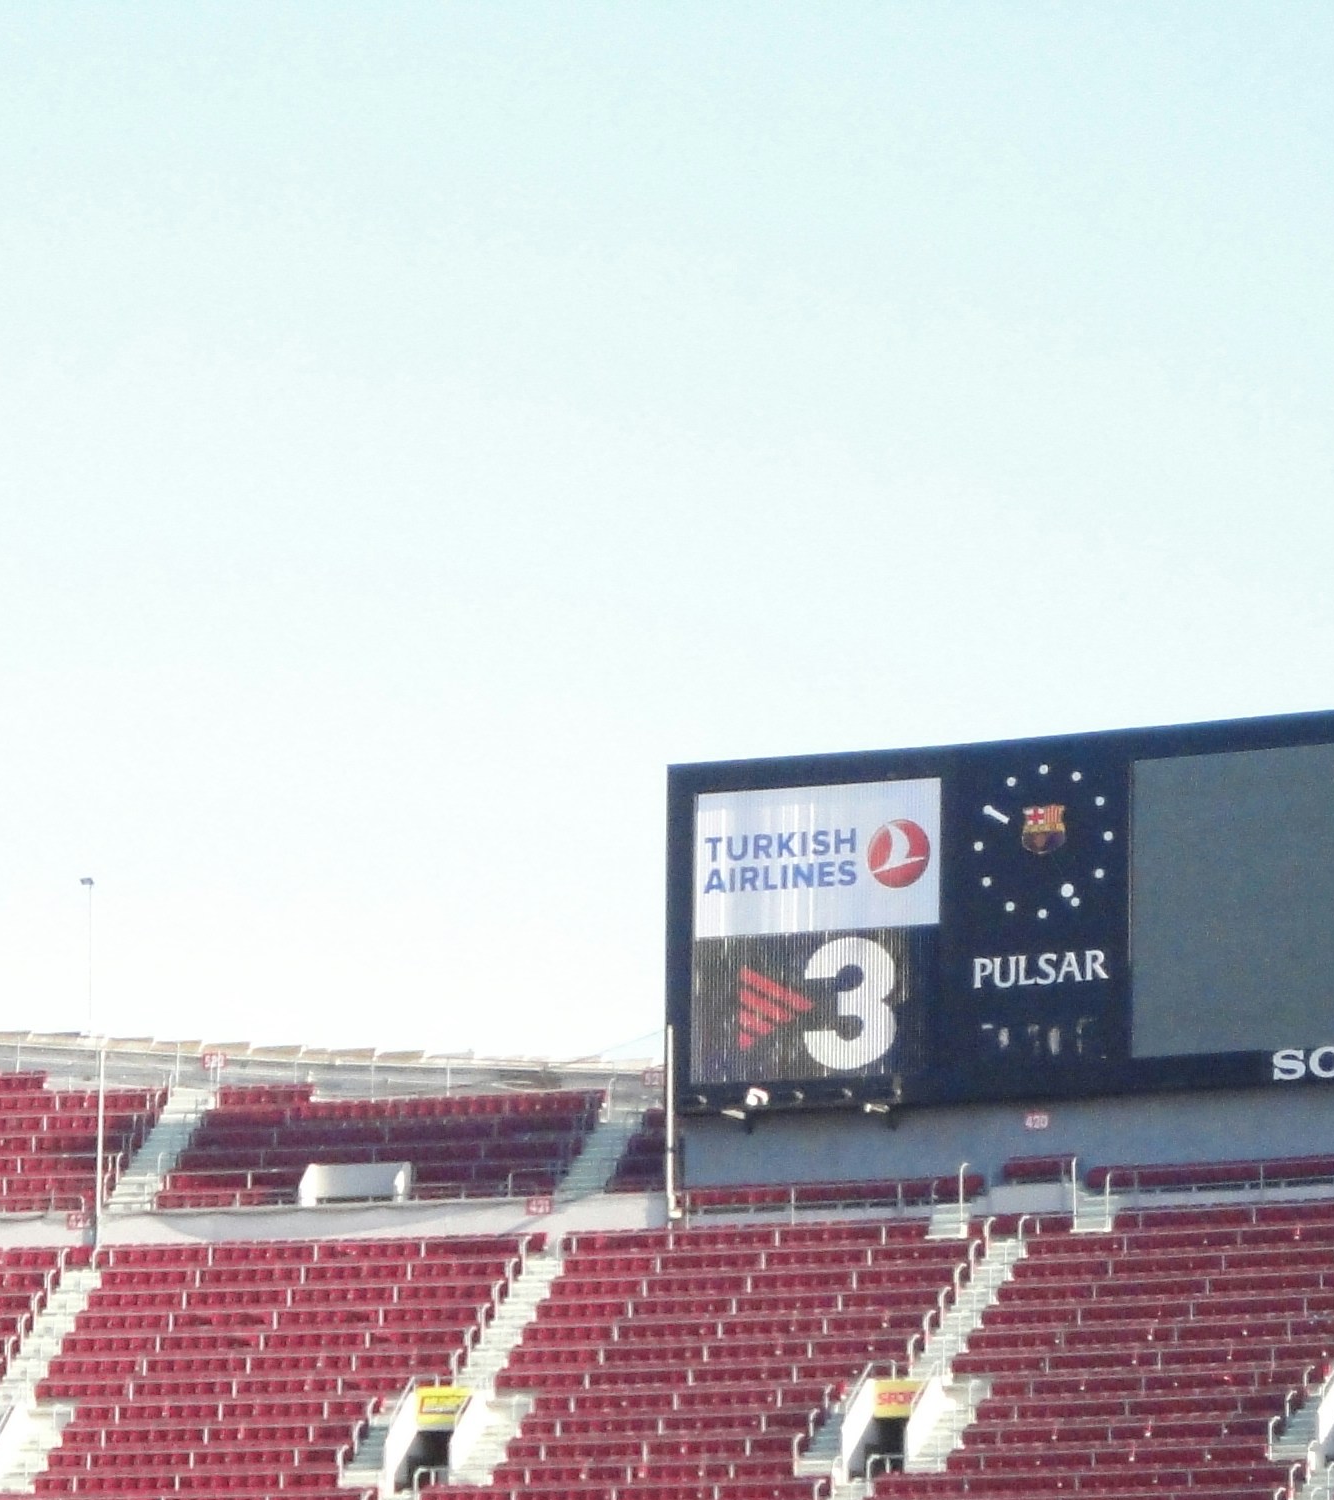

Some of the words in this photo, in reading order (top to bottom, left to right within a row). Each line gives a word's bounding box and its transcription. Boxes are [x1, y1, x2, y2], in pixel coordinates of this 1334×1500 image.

[704, 827, 857, 862] TURKISH
[703, 860, 857, 894] AIRLINES
[973, 949, 1110, 989] PULSAR
[803, 936, 898, 1071] 3
